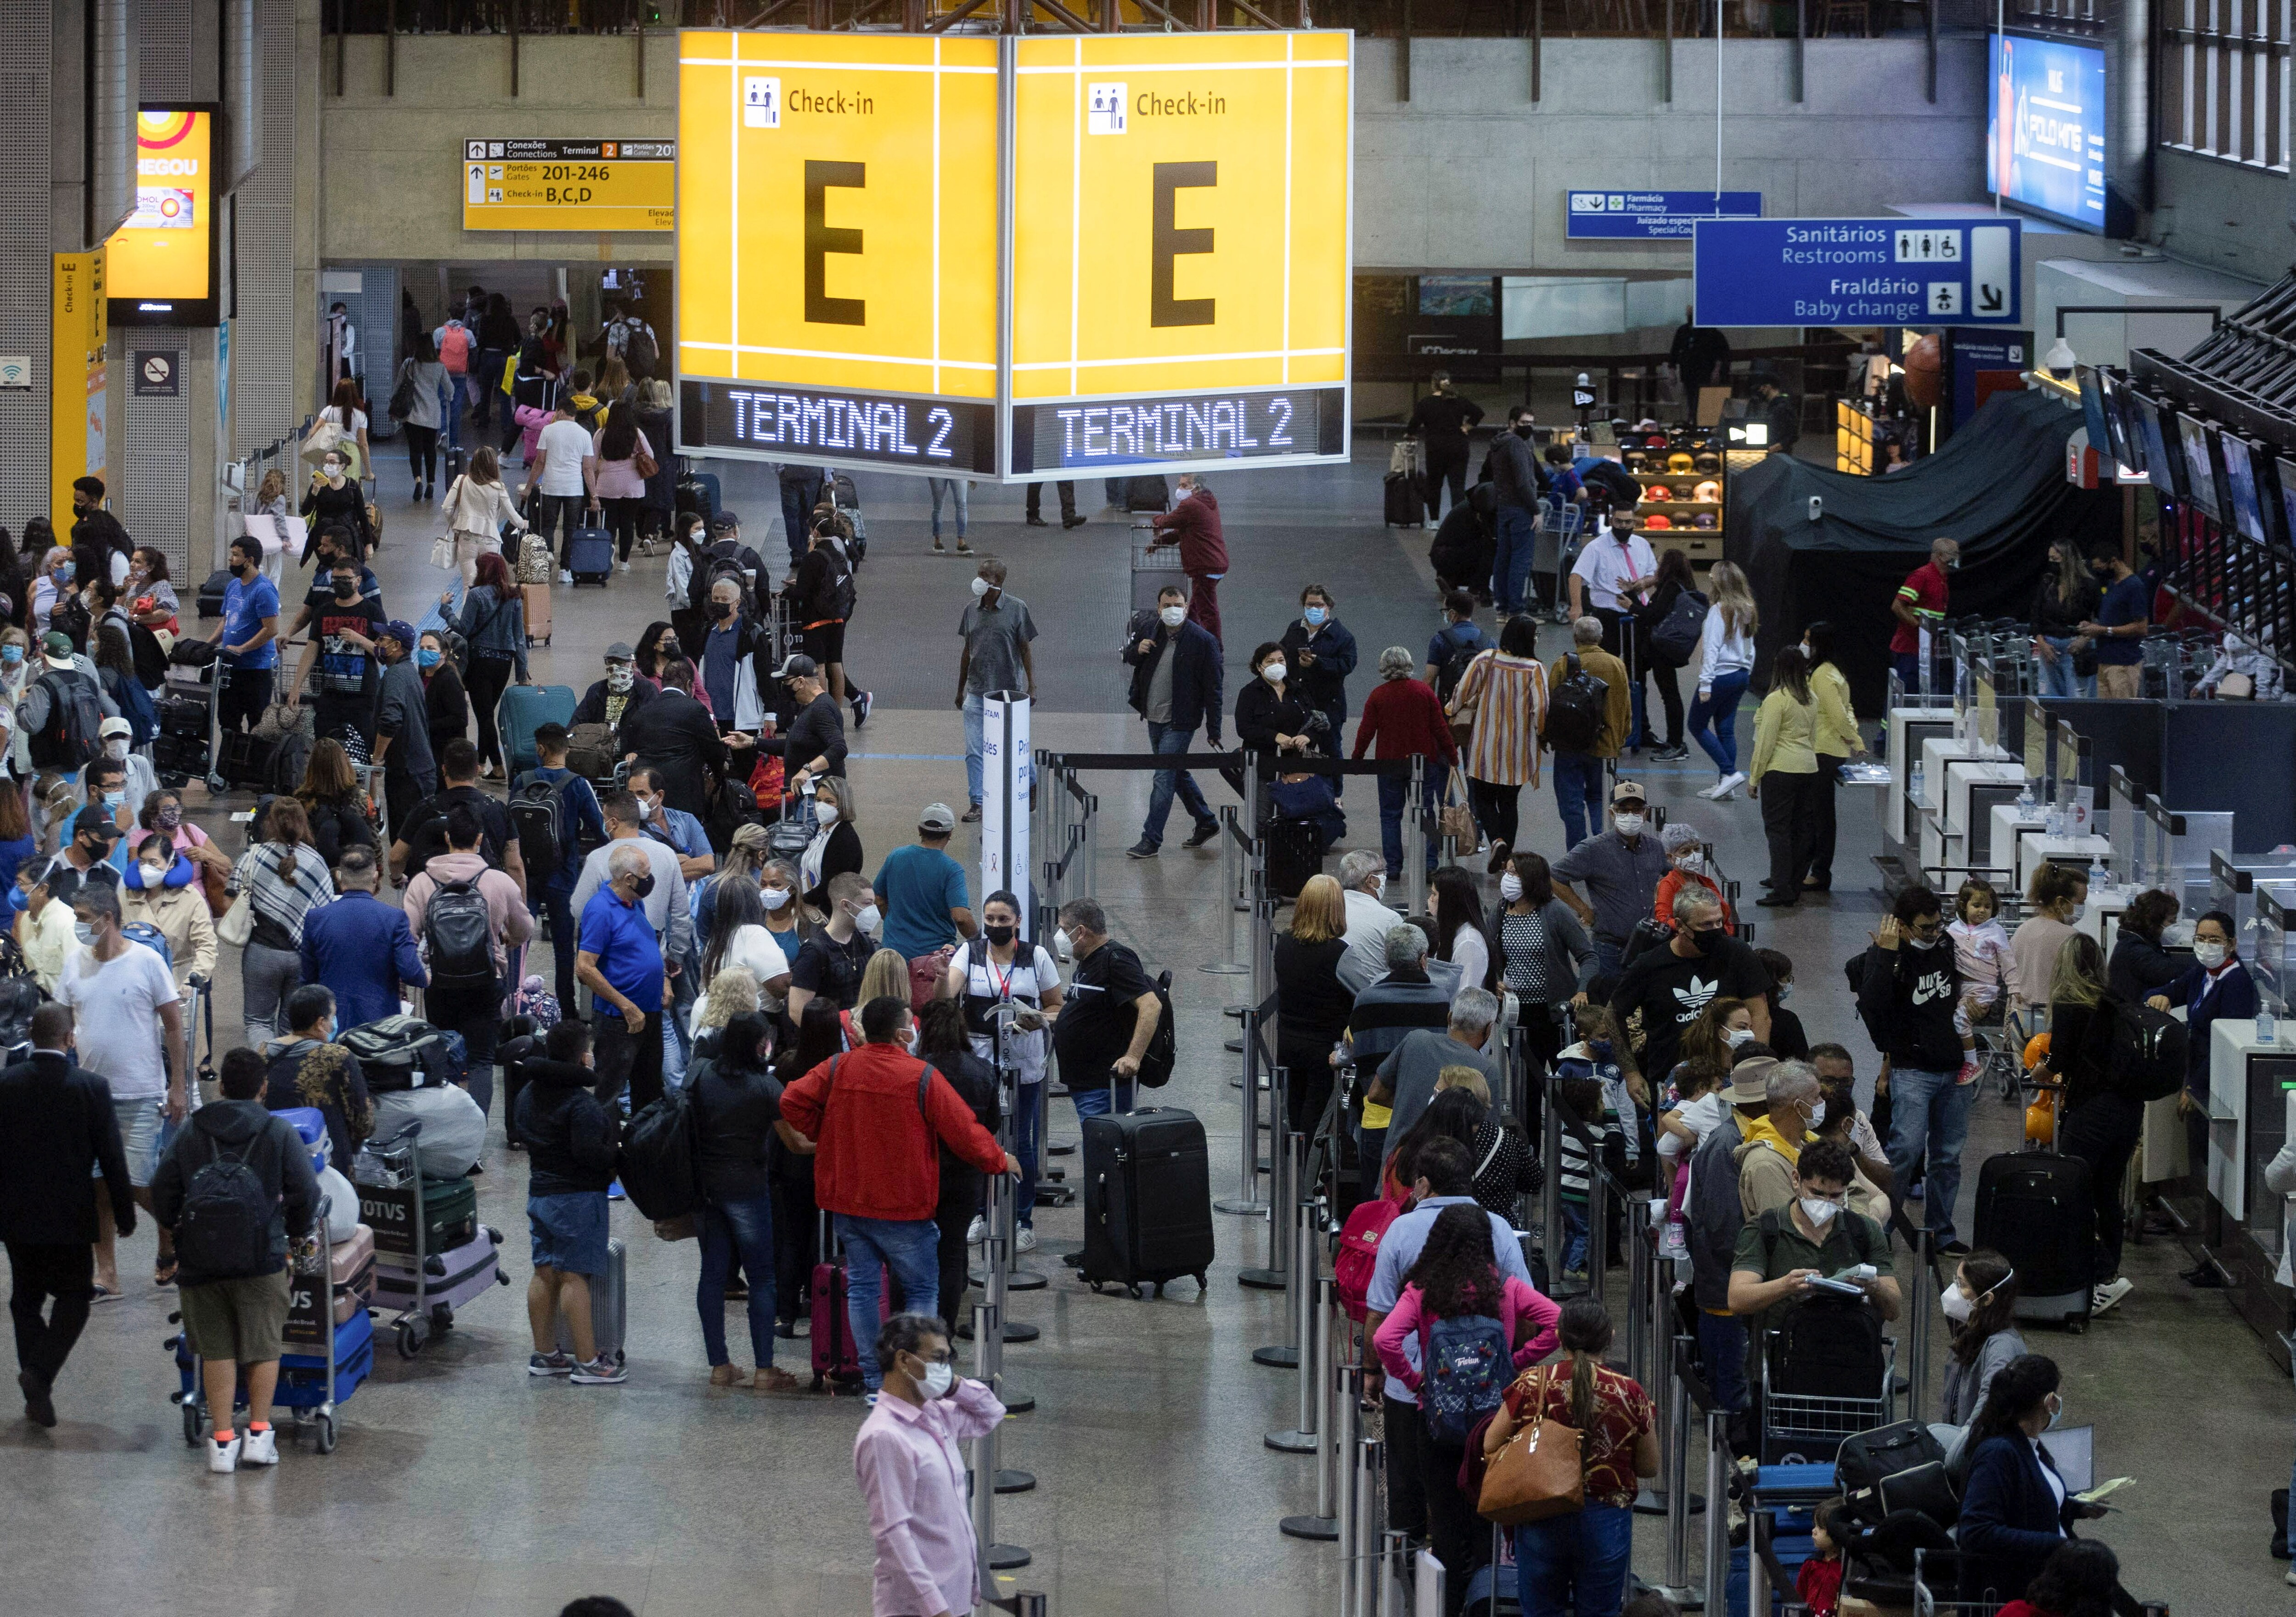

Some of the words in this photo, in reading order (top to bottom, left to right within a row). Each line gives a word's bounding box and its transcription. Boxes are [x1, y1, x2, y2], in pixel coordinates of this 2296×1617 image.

[789, 89, 874, 116] Check-in
[1137, 91, 1226, 117] Check-in
[507, 141, 546, 150] Conexões
[563, 146, 598, 155] Terminal
[606, 145, 613, 156] 2
[507, 150, 557, 158] Connections
[542, 166, 609, 180] 201-246
[507, 190, 543, 198] Check-in
[1627, 204, 1668, 214] Pharmacy
[1637, 217, 1668, 225] Juizado
[1649, 226, 1677, 236] Special
[1786, 225, 1886, 242] Sanitários
[805, 160, 865, 327] E
[1151, 161, 1218, 328] E
[1783, 248, 1886, 264] Restrooms
[62, 263, 76, 271] E
[64, 275, 73, 313] Check-in
[1830, 278, 1919, 295] Fraldário
[1794, 300, 1842, 320] Baby
[1847, 300, 1920, 320] change
[729, 390, 918, 453] TERMINAL
[928, 408, 953, 457] 2
[1057, 400, 1259, 457] TERMINAL
[1268, 399, 1293, 446] 2
[1939, 983, 1951, 998] SB
[360, 1198, 405, 1221] OTVS
